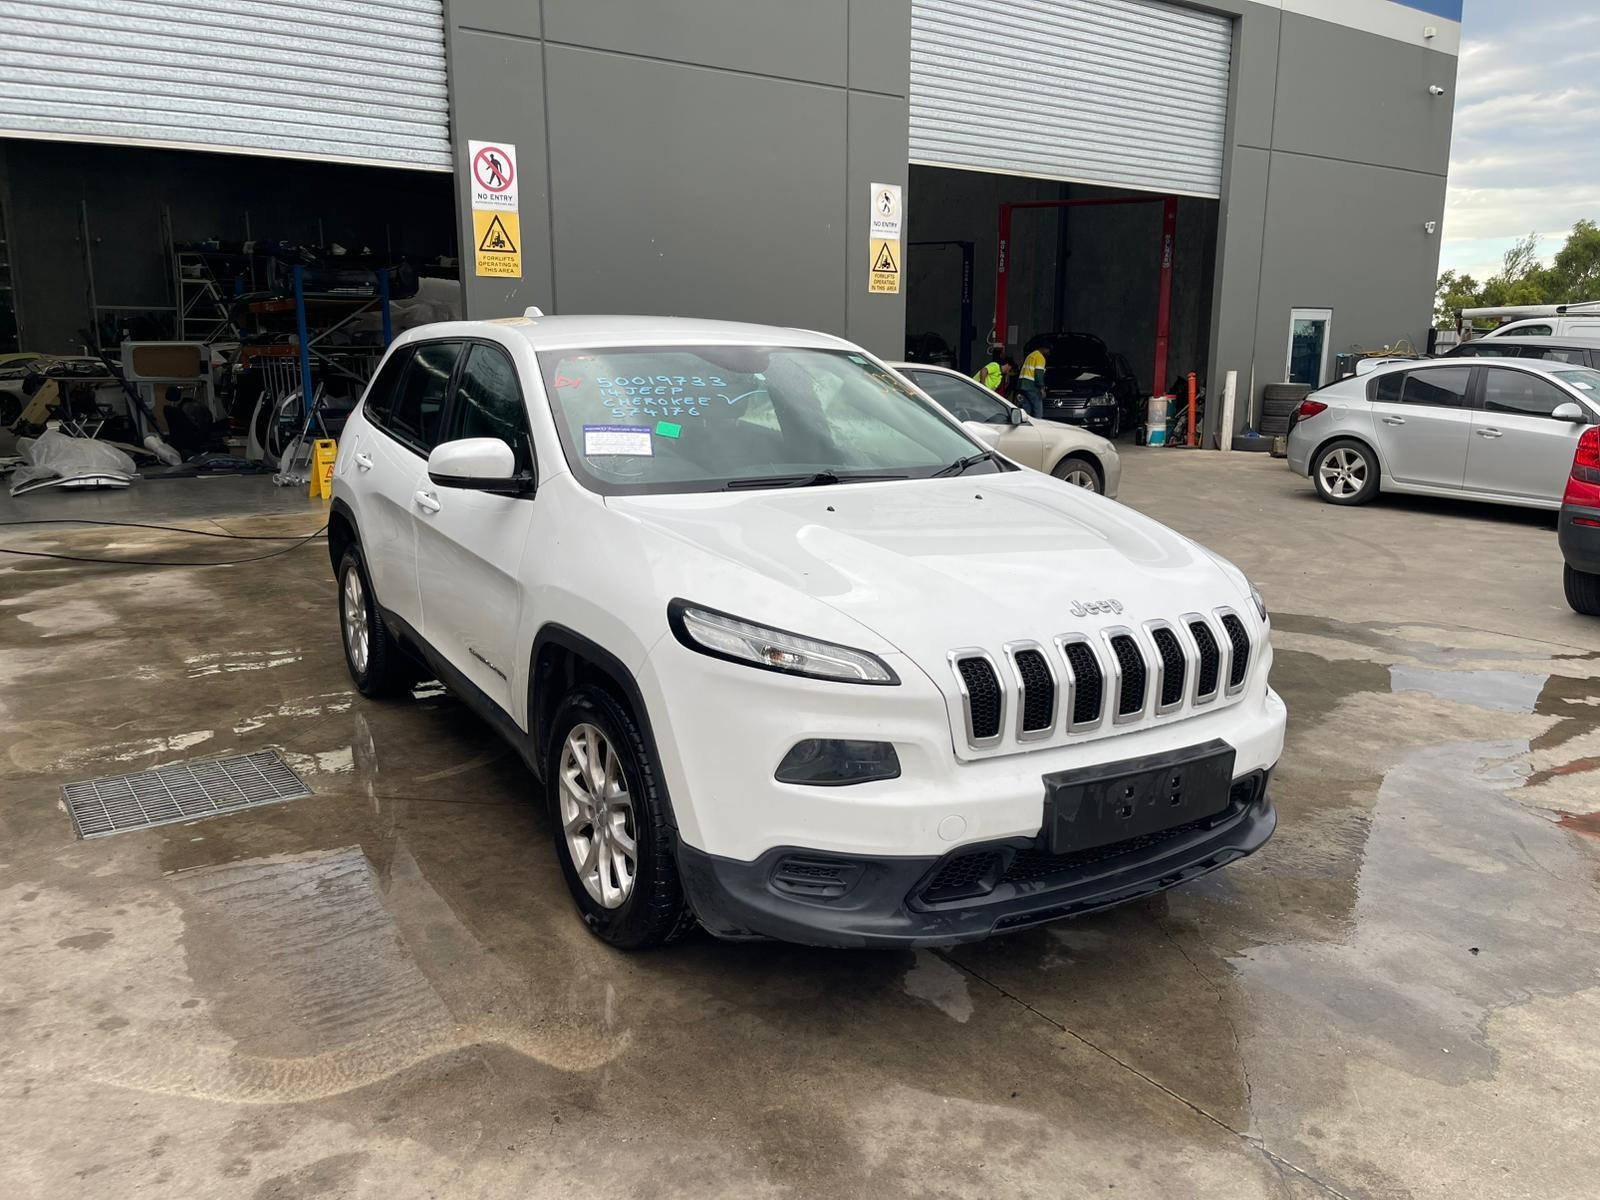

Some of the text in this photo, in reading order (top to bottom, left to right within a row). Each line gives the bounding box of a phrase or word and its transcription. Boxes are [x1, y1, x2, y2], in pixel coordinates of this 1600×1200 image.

[490, 193, 513, 202] ENTRY
[882, 221, 898, 229] ENTRY
[596, 375, 728, 388] 50019733
[626, 386, 684, 396] JEEP
[603, 397, 711, 407] CHEROKEE
[611, 407, 701, 418] 574176
[1070, 598, 1124, 617] Jeep
